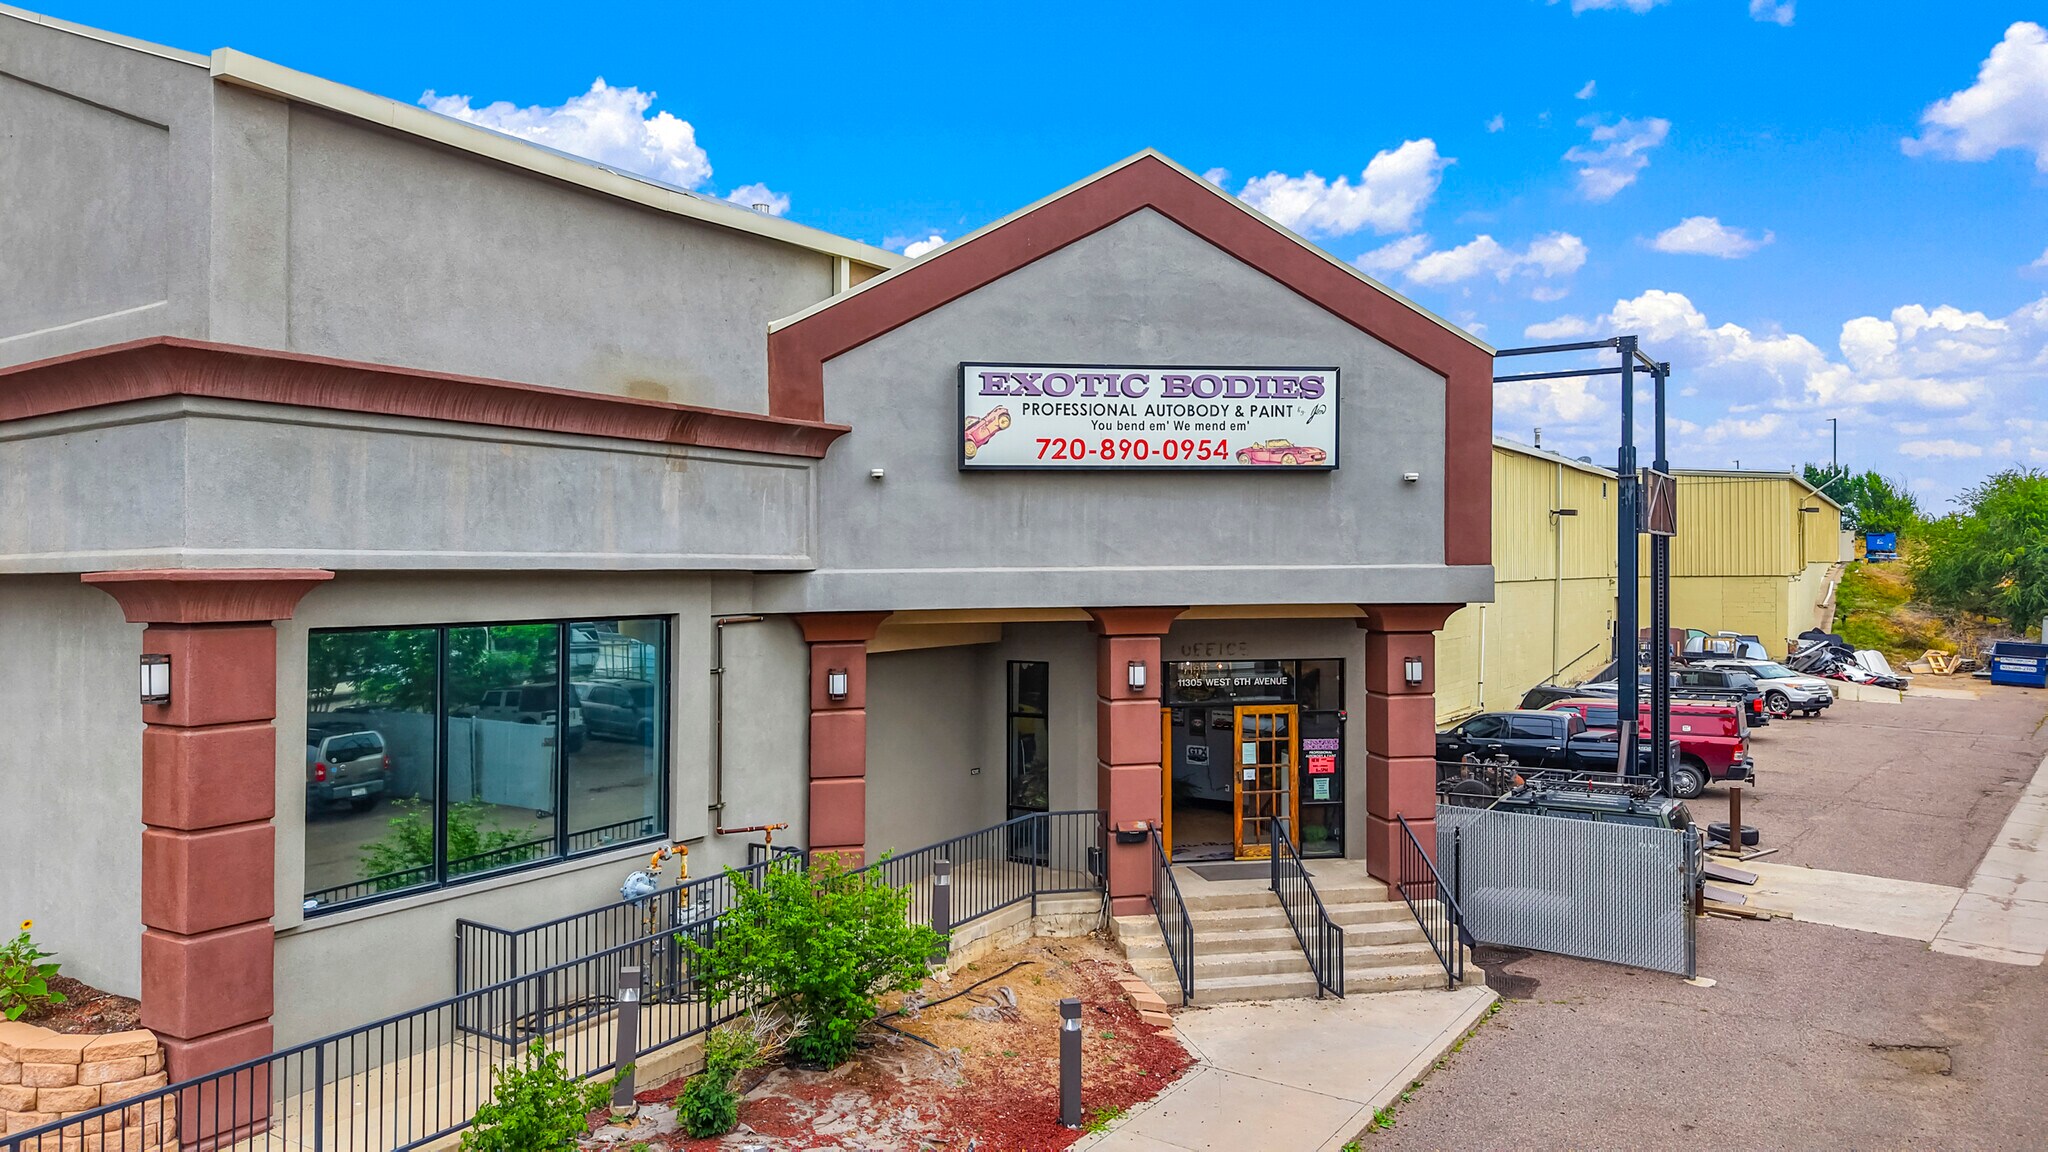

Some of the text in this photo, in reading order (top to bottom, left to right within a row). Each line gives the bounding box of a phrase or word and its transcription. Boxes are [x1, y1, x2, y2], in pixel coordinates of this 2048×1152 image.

[979, 372, 1325, 399] EXOTIC BODIES
[1022, 402, 1137, 417] PROFESSIONAL
[1145, 404, 1229, 417] AUTOBODY
[1235, 404, 1244, 418] &
[1250, 405, 1293, 418] PAINT
[1091, 419, 1250, 431] You bend em' We mend em'
[1036, 438, 1229, 460] 720-890-0954
[1178, 677, 1288, 687] 11305 WEST 6TH AVENUE
